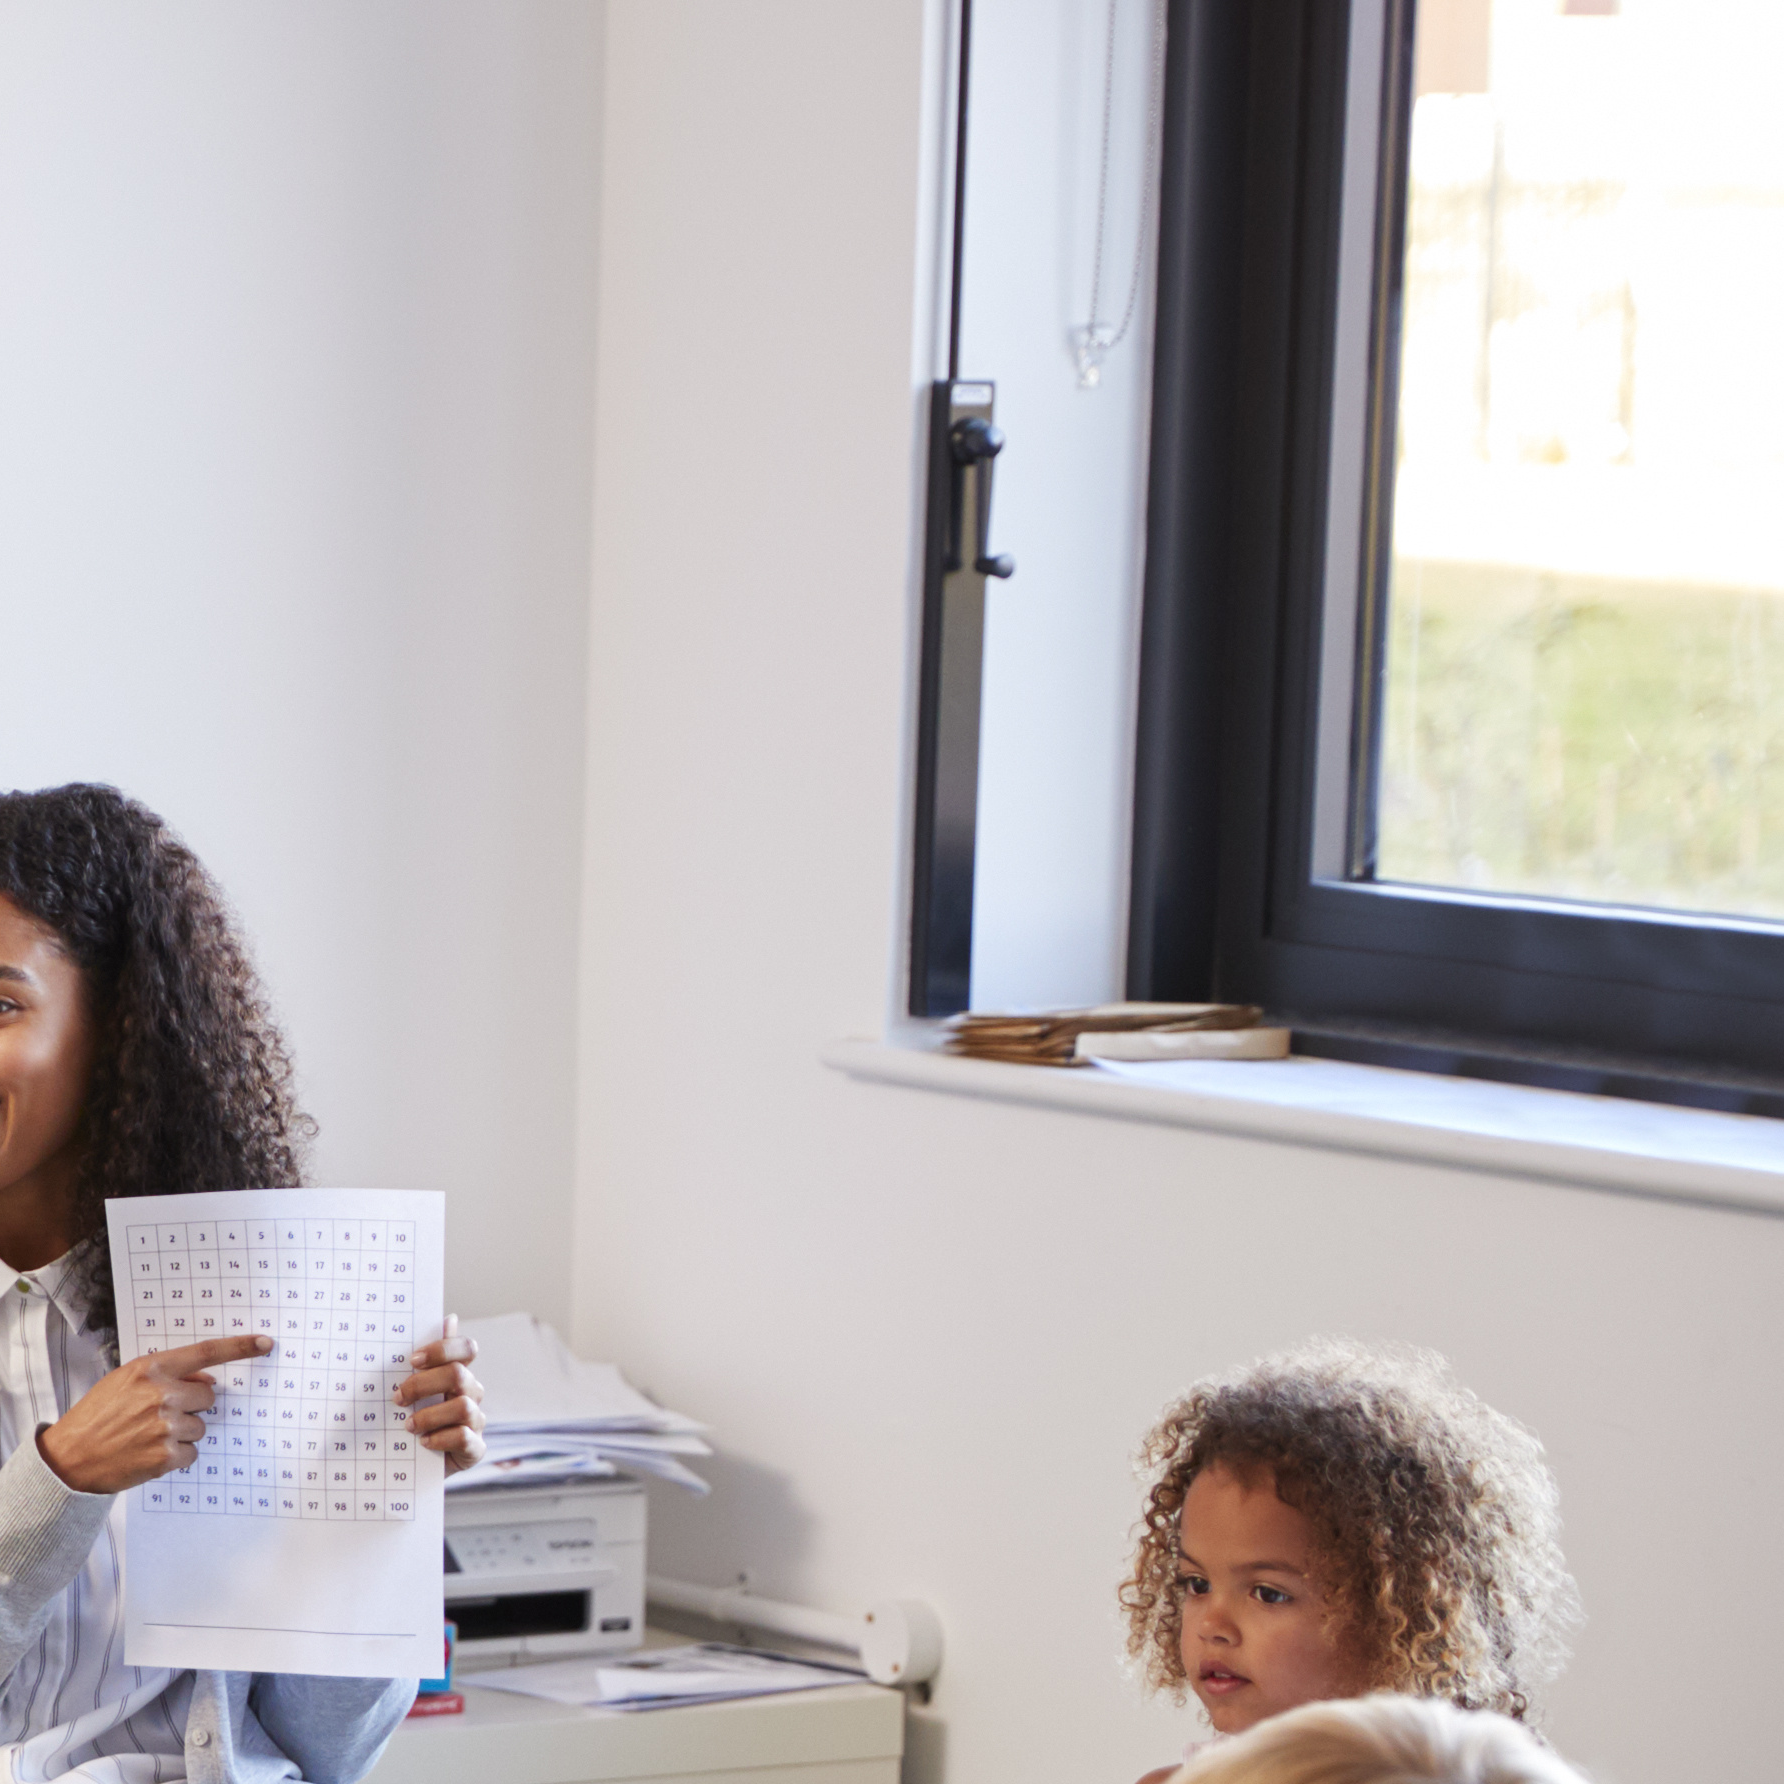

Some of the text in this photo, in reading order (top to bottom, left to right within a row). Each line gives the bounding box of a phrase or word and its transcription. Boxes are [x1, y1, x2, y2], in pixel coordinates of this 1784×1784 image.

[140, 1230, 407, 1245] 1 2 3 4 5 6 7 8 9 10
[140, 1259, 407, 1274] 11 12 13 14 15 16 17 18 19 20
[142, 1288, 406, 1304] 21 22 23 24 25 26 27 28 29 30
[145, 1317, 406, 1334] 31 32 33 34 35 36 37 38 39 40
[334, 1441, 408, 1452] 78 79 80
[206, 1465, 408, 1482] 83 84 85 86 87 88 89 90
[151, 1493, 410, 1512] 91 92 93 94 95 96 97 98 99 100
